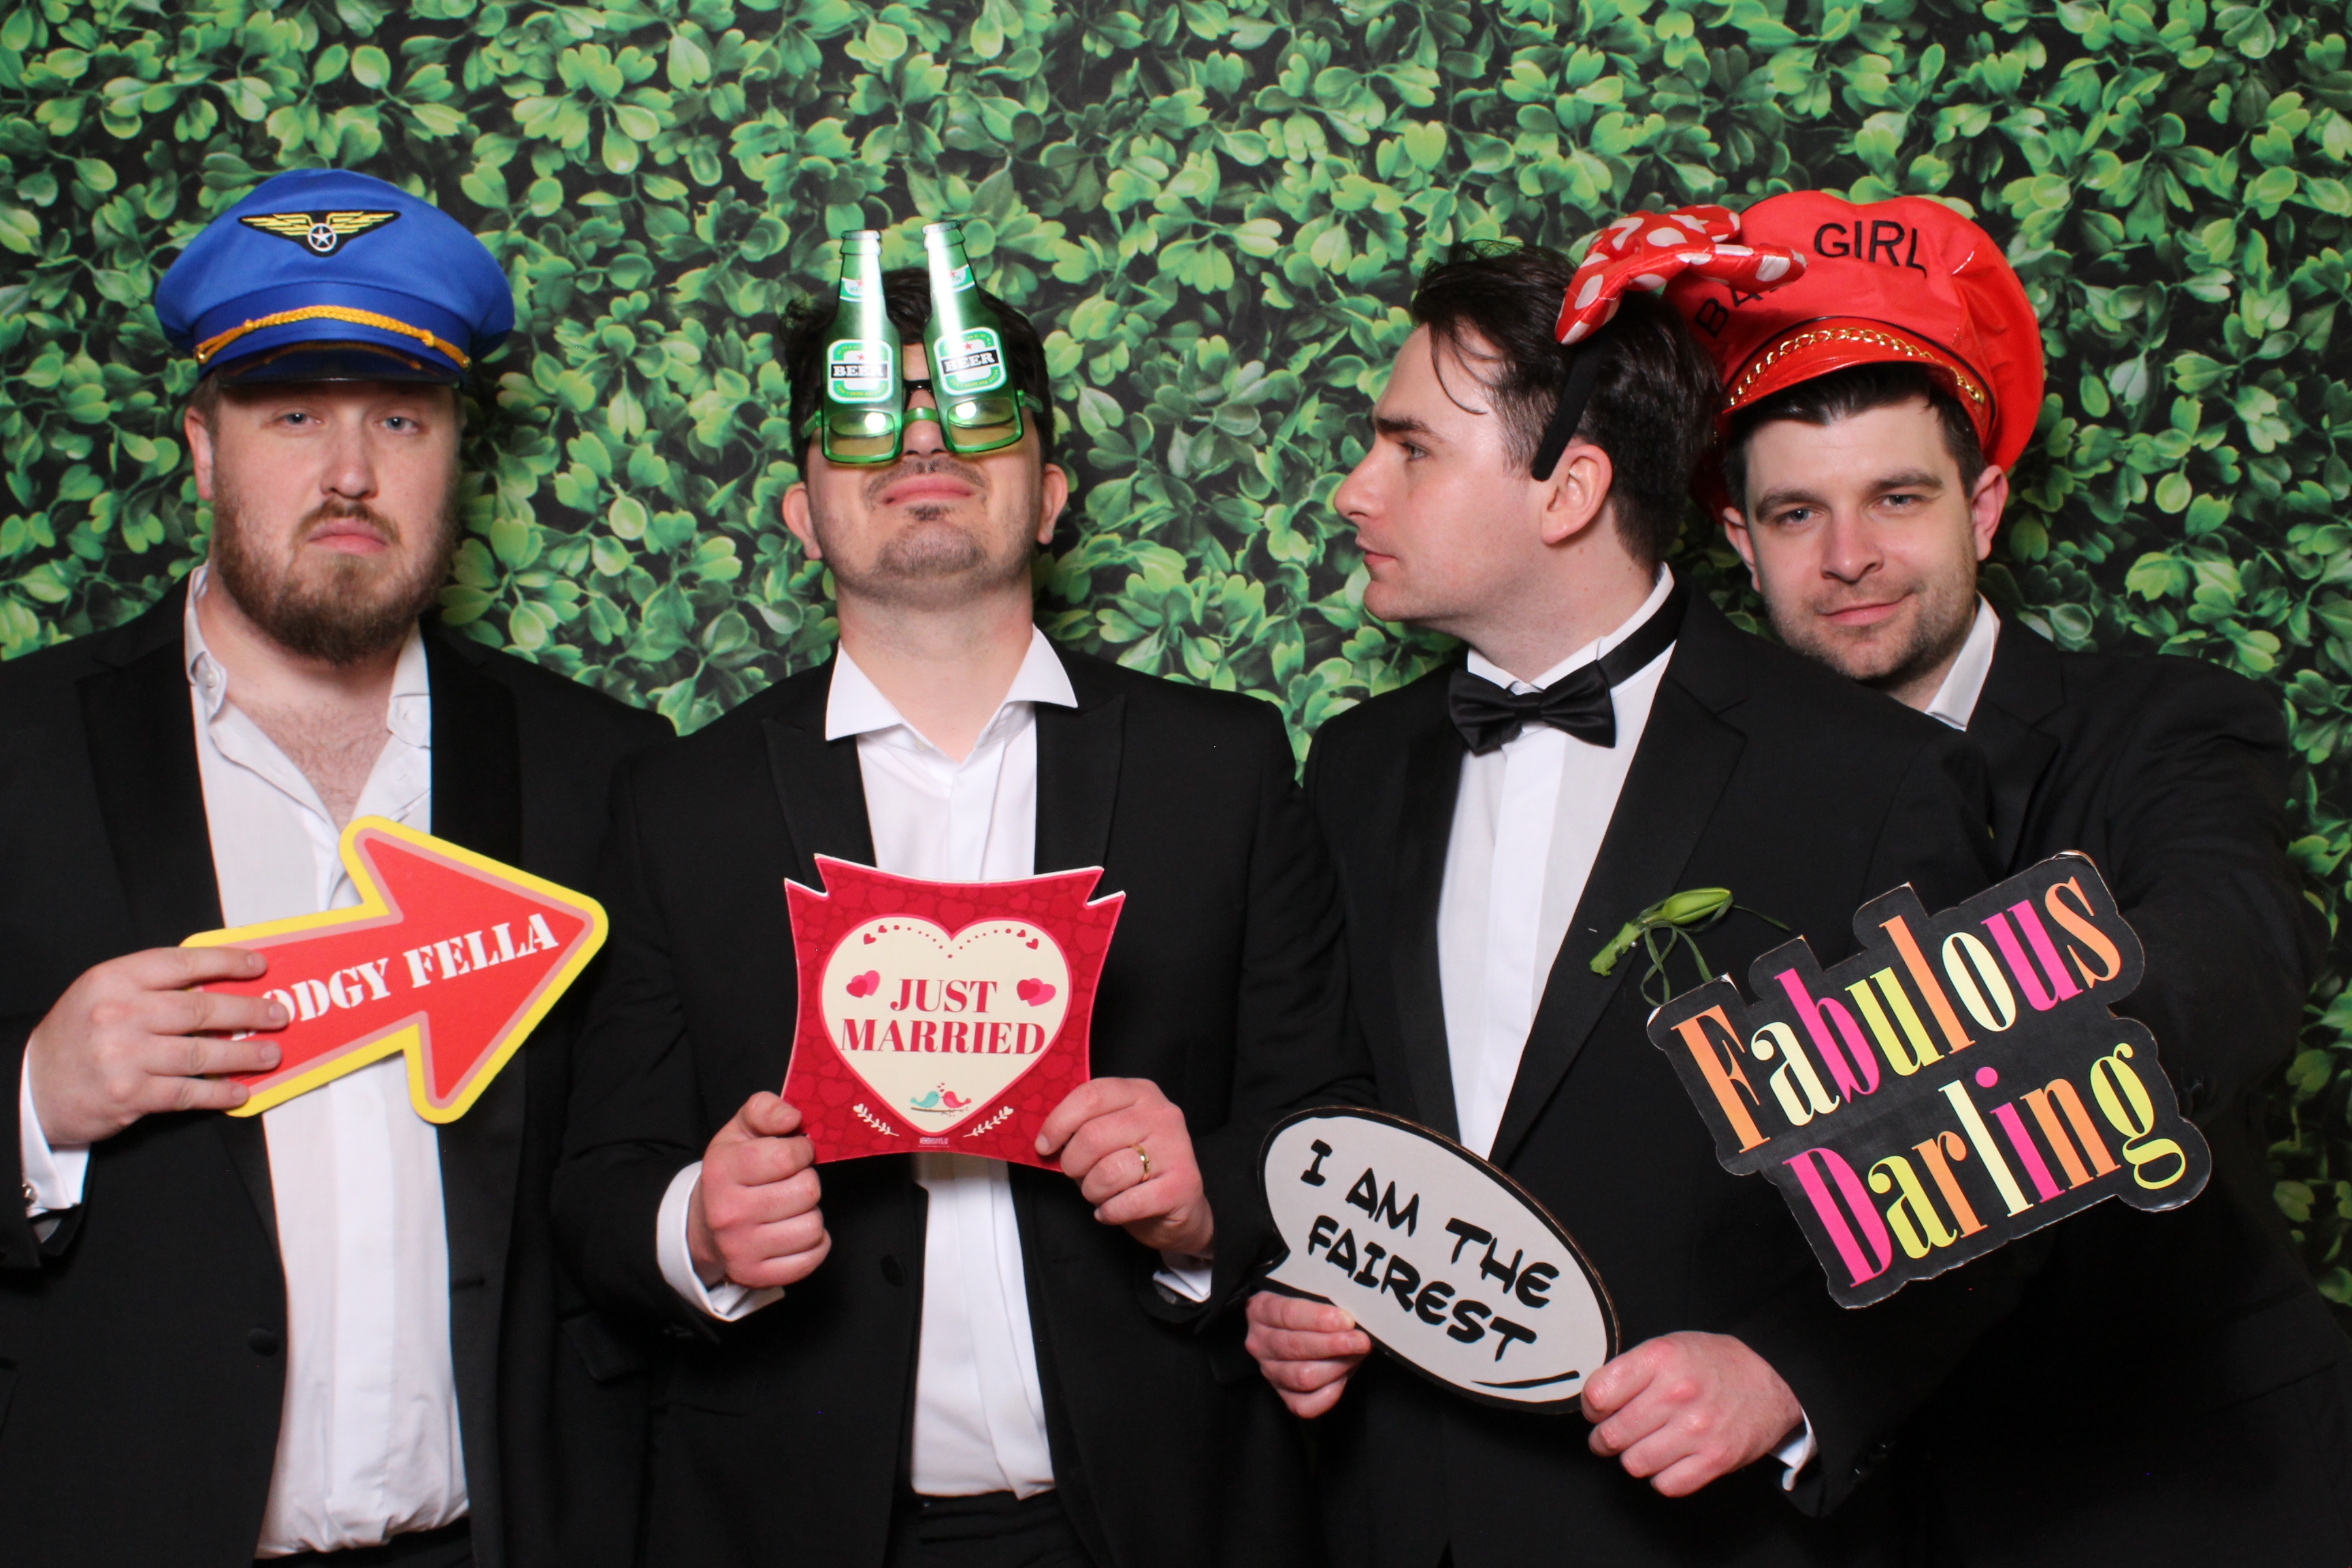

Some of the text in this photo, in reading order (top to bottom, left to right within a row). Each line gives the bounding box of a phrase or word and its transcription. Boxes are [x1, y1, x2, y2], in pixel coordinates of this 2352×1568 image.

[1694, 220, 1927, 339] BA GIRL
[833, 365, 885, 377] BEER
[944, 352, 995, 372] BEER
[231, 913, 558, 1042] ODGY FELLA
[839, 1018, 1046, 1054] MARRIED
[889, 978, 998, 1013] JUST
[1671, 876, 2122, 1154] Fabulous
[1301, 1139, 1560, 1309] I AM THE
[1782, 1043, 2187, 1288] Darling
[1308, 1215, 1537, 1362] FAIREST
